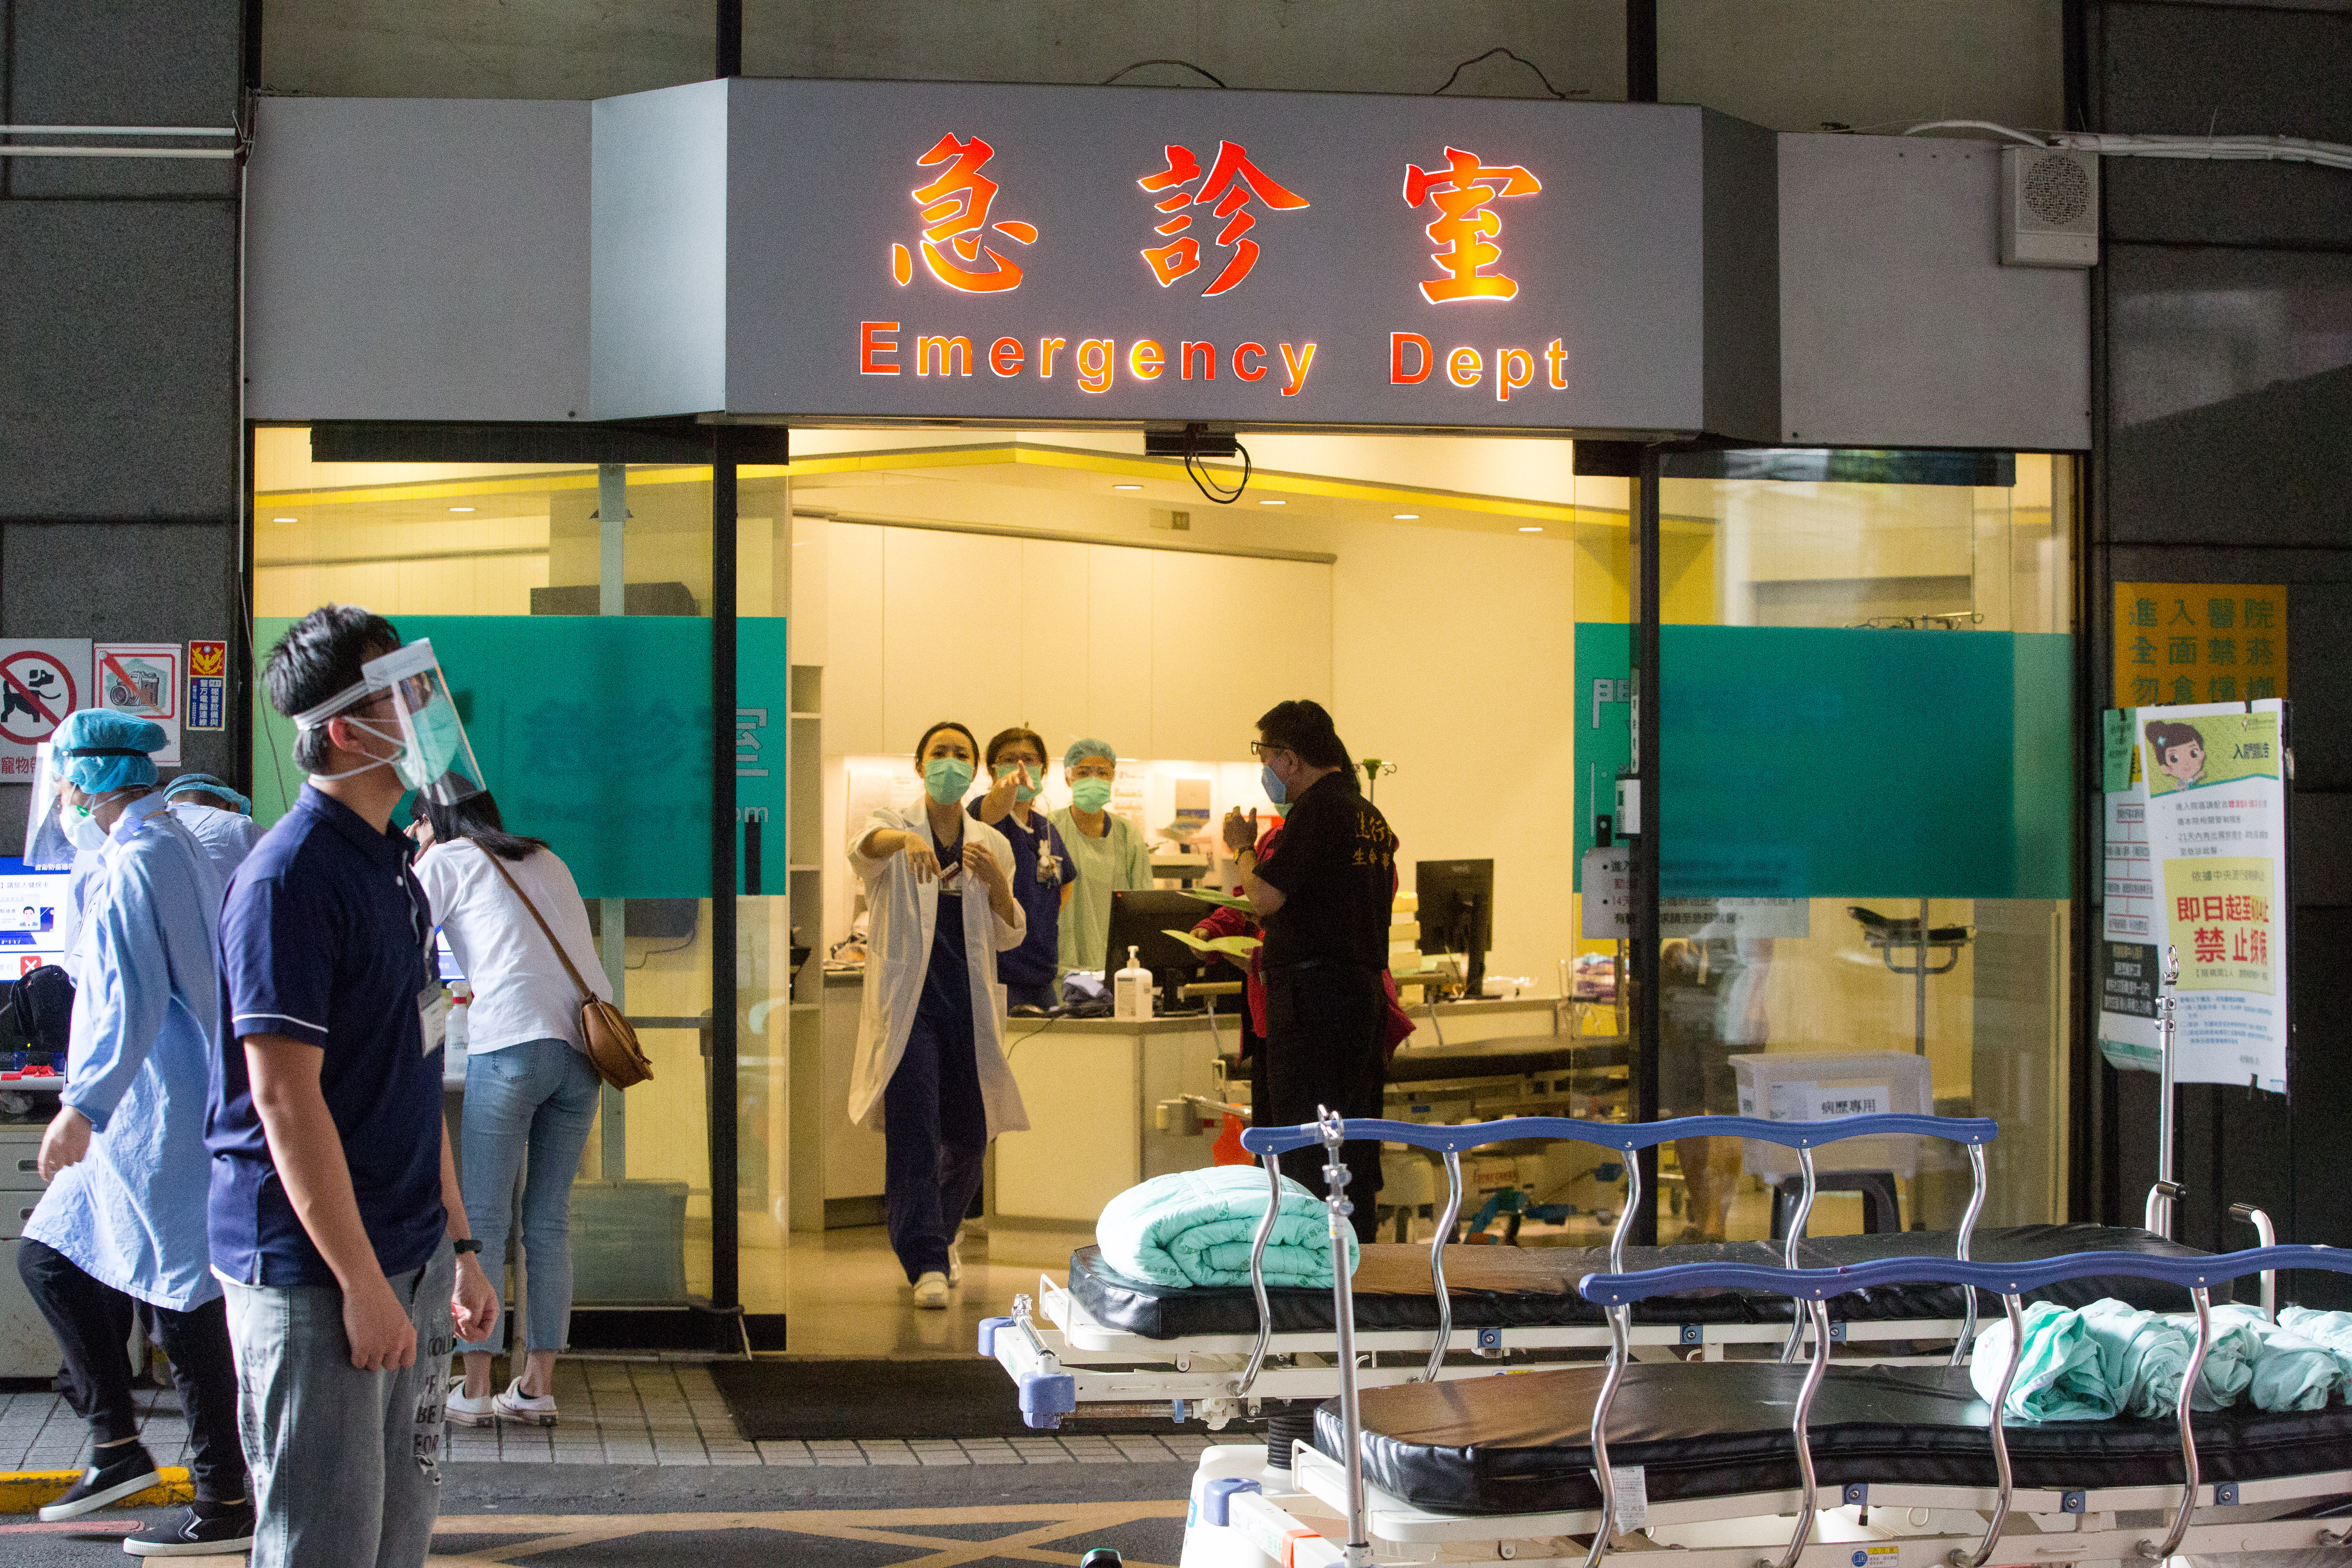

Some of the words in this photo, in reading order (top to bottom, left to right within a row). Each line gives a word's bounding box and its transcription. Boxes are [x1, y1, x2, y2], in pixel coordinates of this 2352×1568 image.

[891, 131, 1543, 305] 急診室
[859, 320, 1318, 397] Emergency
[1389, 331, 1569, 402] Dept
[2129, 598, 2275, 628] 進入醫院
[2129, 636, 2275, 666] 全面禁菸
